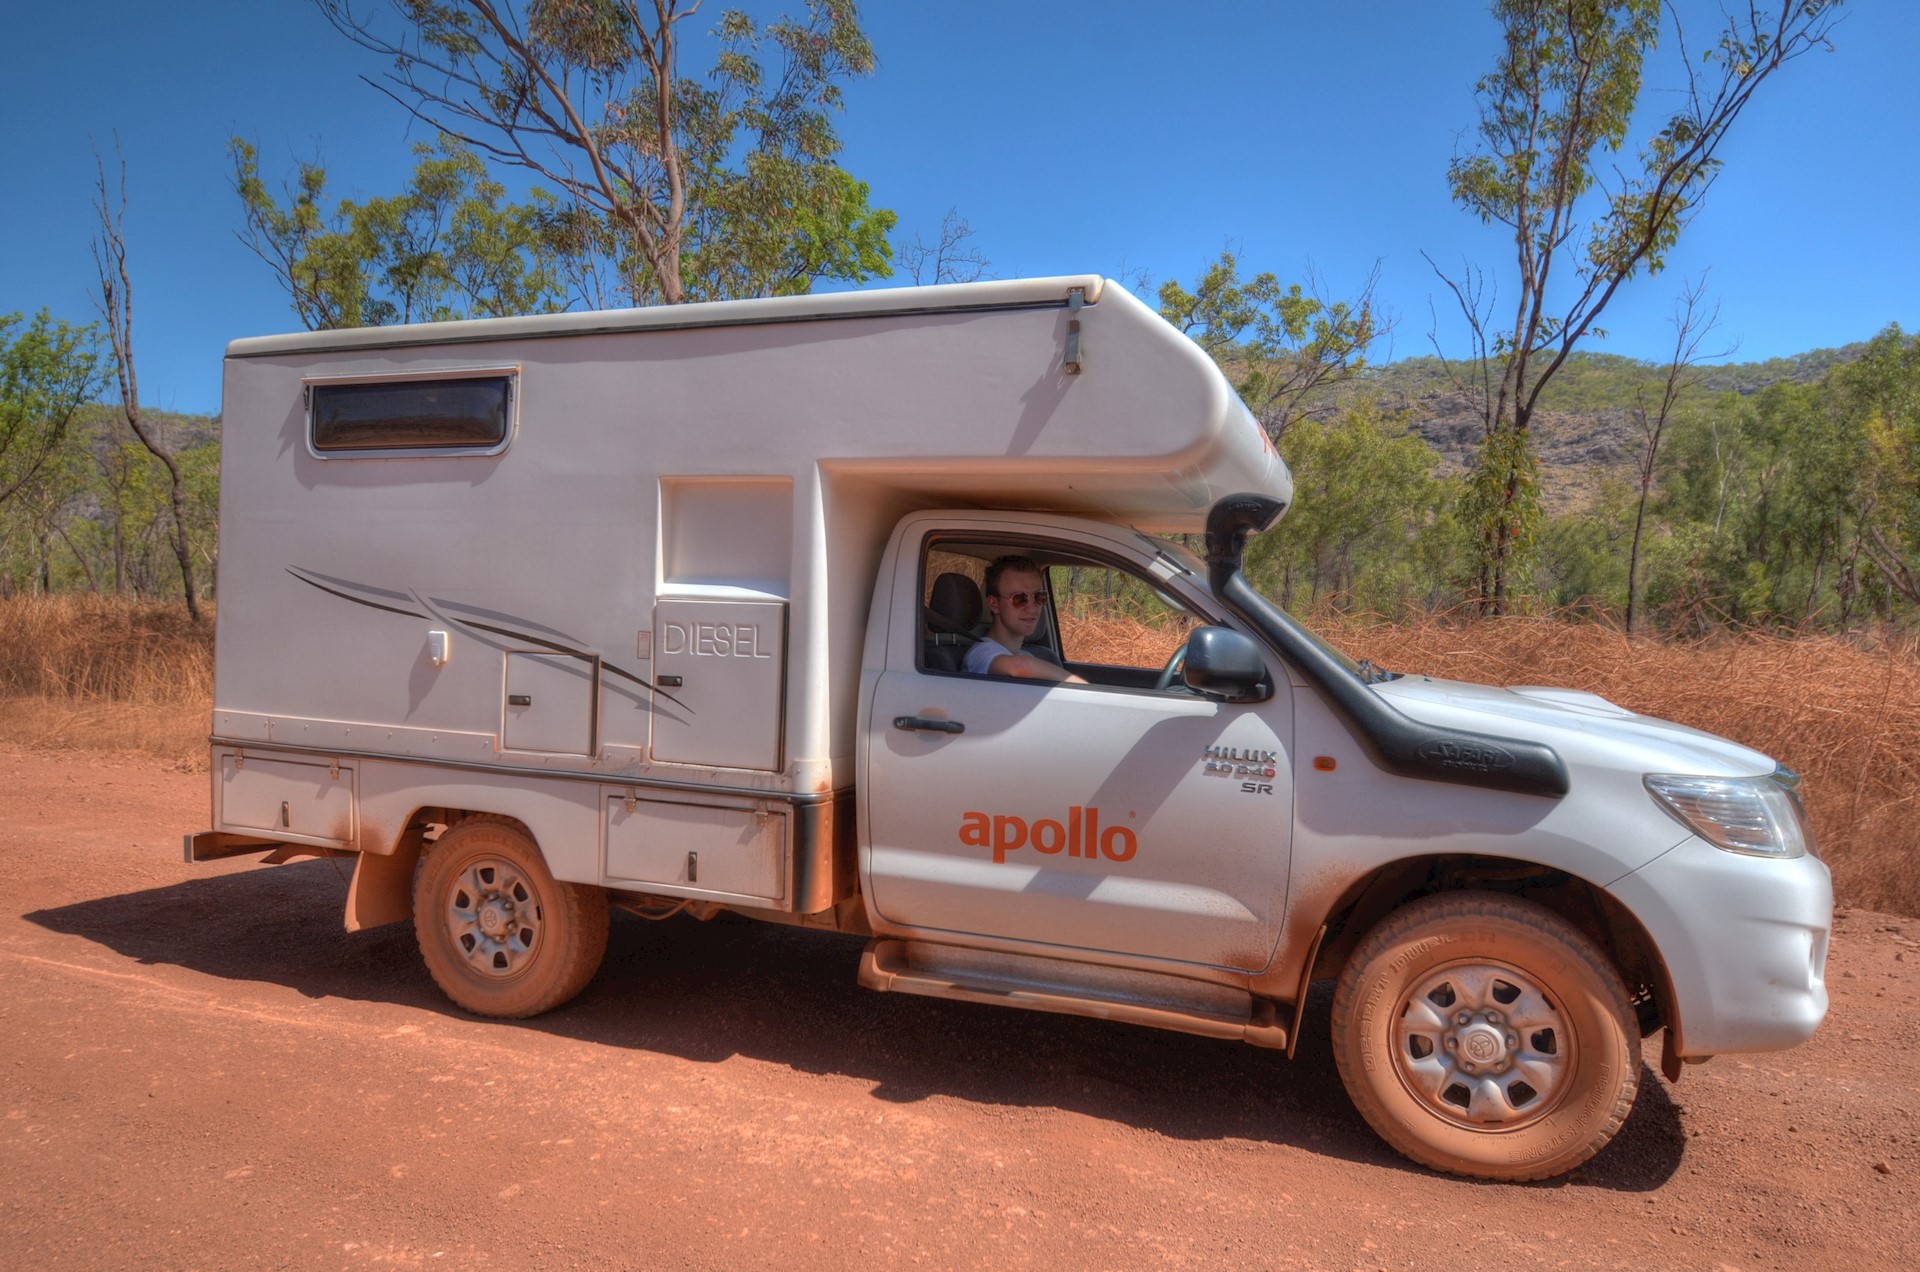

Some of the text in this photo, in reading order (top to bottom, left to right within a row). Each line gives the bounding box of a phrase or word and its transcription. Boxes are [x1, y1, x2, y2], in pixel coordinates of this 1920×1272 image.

[663, 622, 771, 658] DIESEL
[1202, 744, 1277, 766] HILUX
[1240, 782, 1273, 795] SR
[959, 806, 1138, 864] apollo
[1360, 972, 1390, 1073] DESERT
